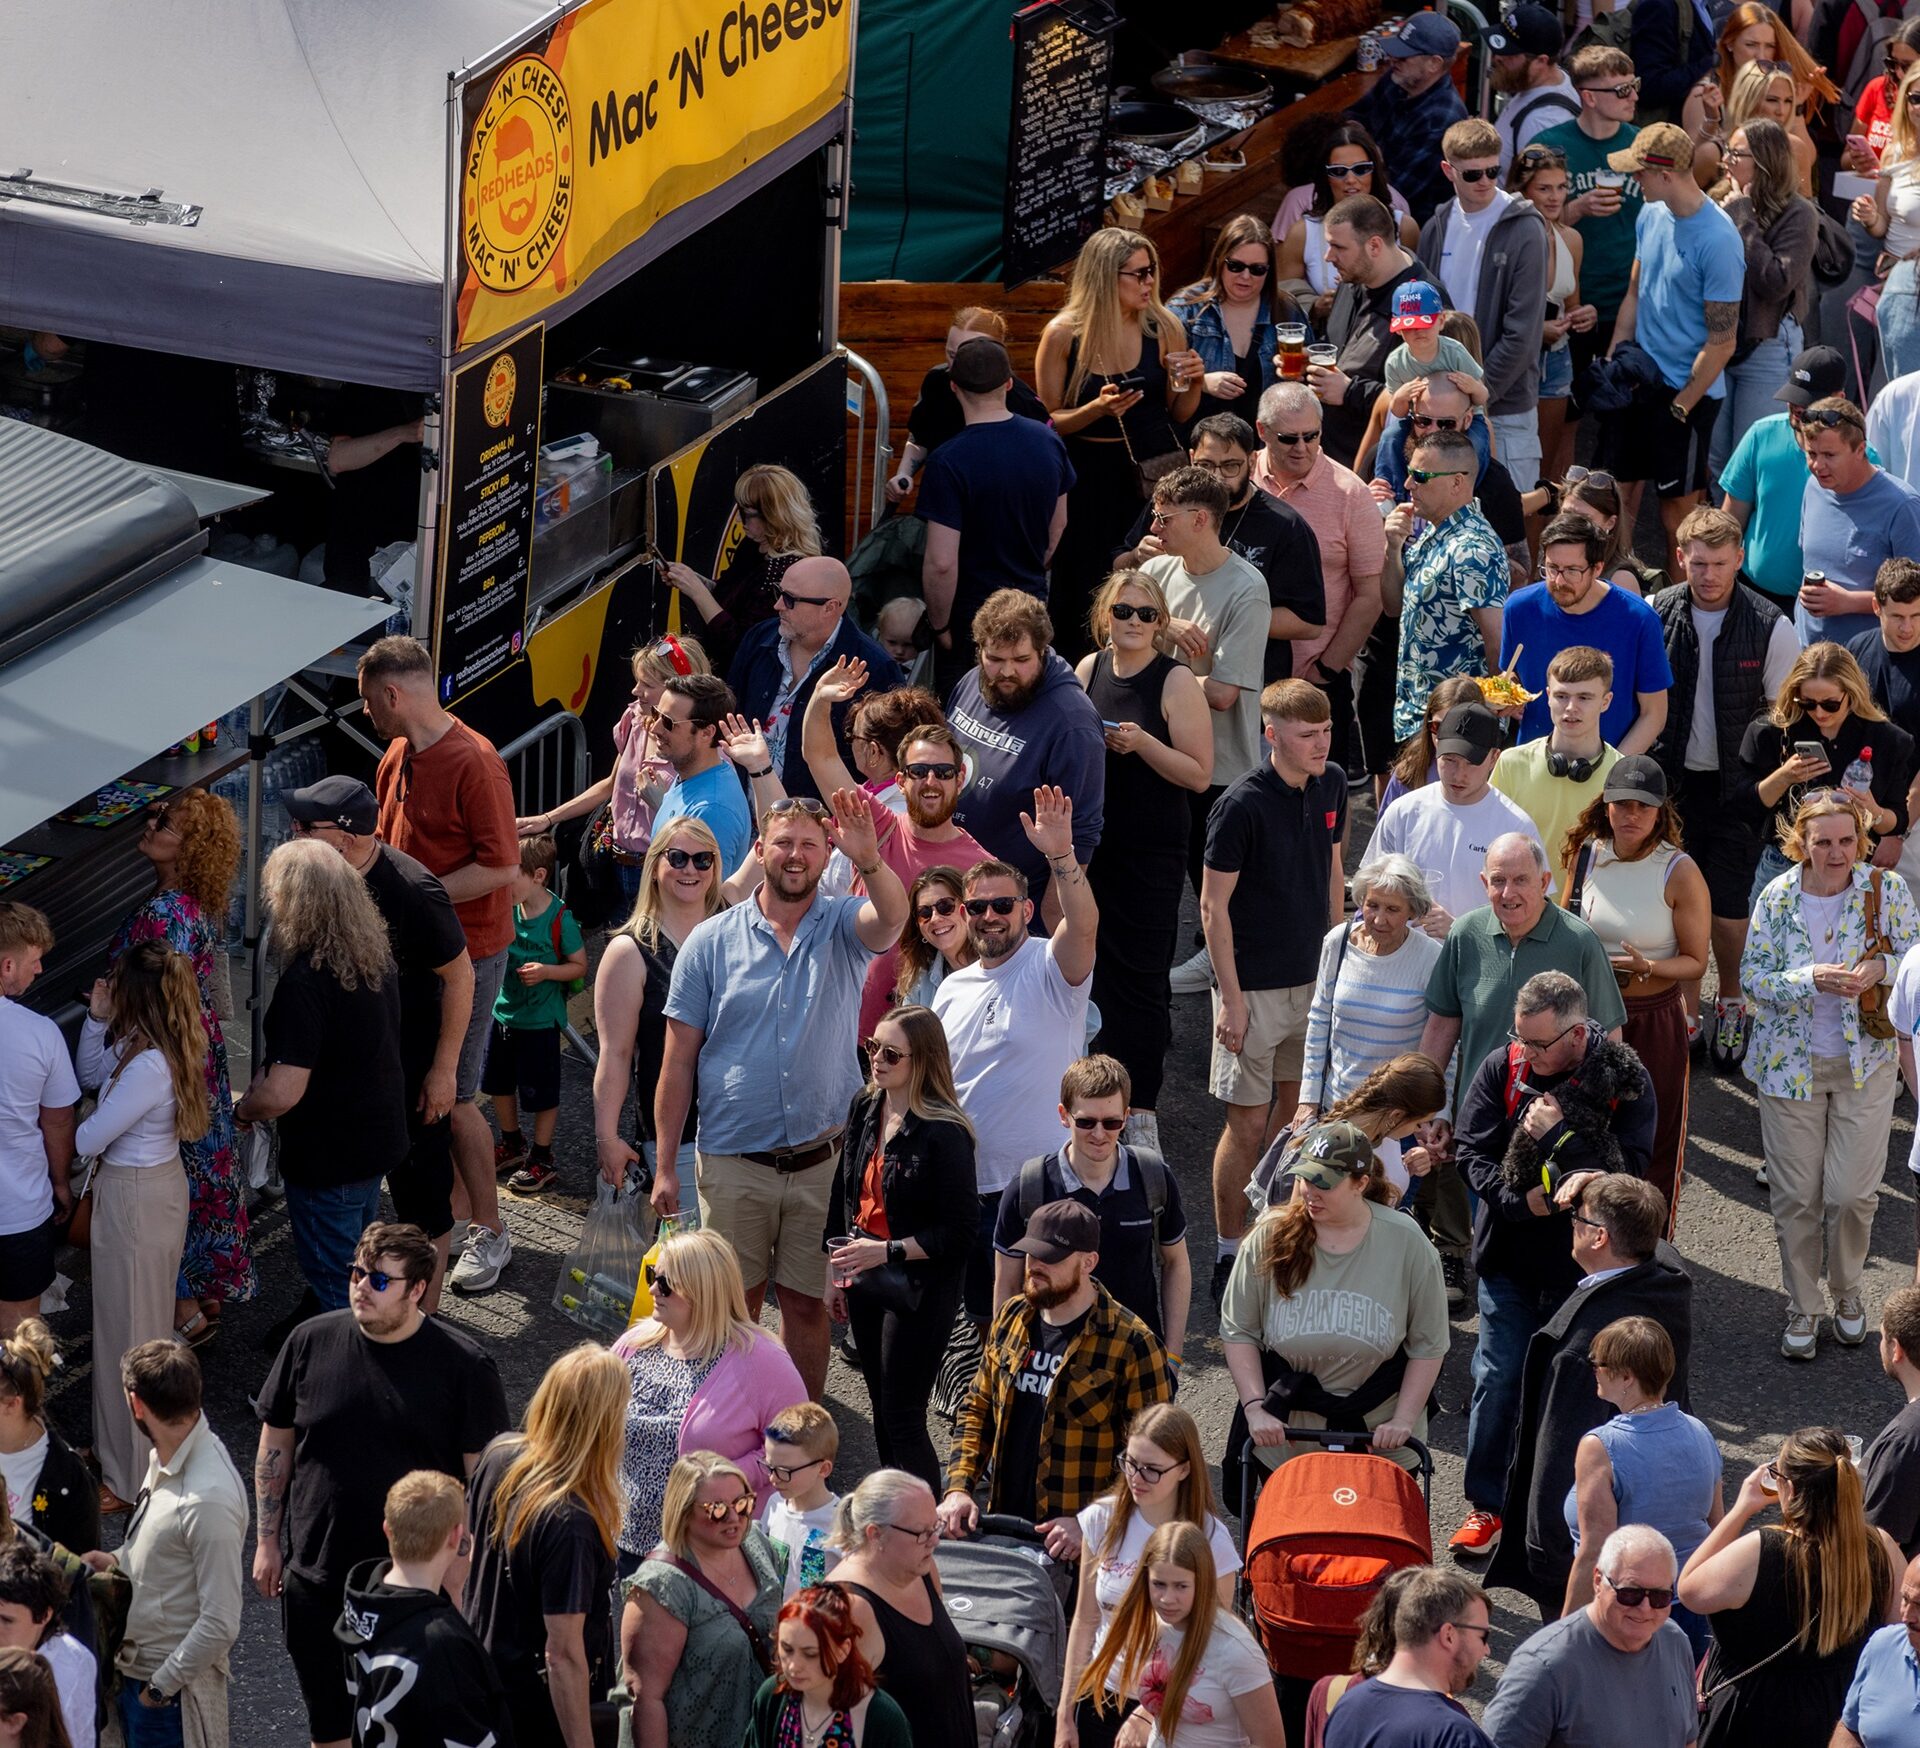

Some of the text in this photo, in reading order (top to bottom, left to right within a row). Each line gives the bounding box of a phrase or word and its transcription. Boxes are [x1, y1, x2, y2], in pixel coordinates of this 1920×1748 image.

[589, 79, 658, 168] Mac
[668, 29, 709, 110] 'N'
[469, 65, 569, 180] MAC 'N' CHEESE
[480, 152, 555, 207] REDHEADS
[468, 174, 571, 283] MAC 'N' CHEESE
[480, 440, 507, 464] ORIGINAL
[481, 473, 510, 500] STICKY RIB
[479, 521, 506, 546] PEPERONI
[724, 523, 742, 567] AC
[483, 576, 495, 591] BBQ
[947, 706, 1027, 756] Lambretta
[978, 776, 994, 790] 47
[1300, 1289, 1396, 1358] ANGELES
